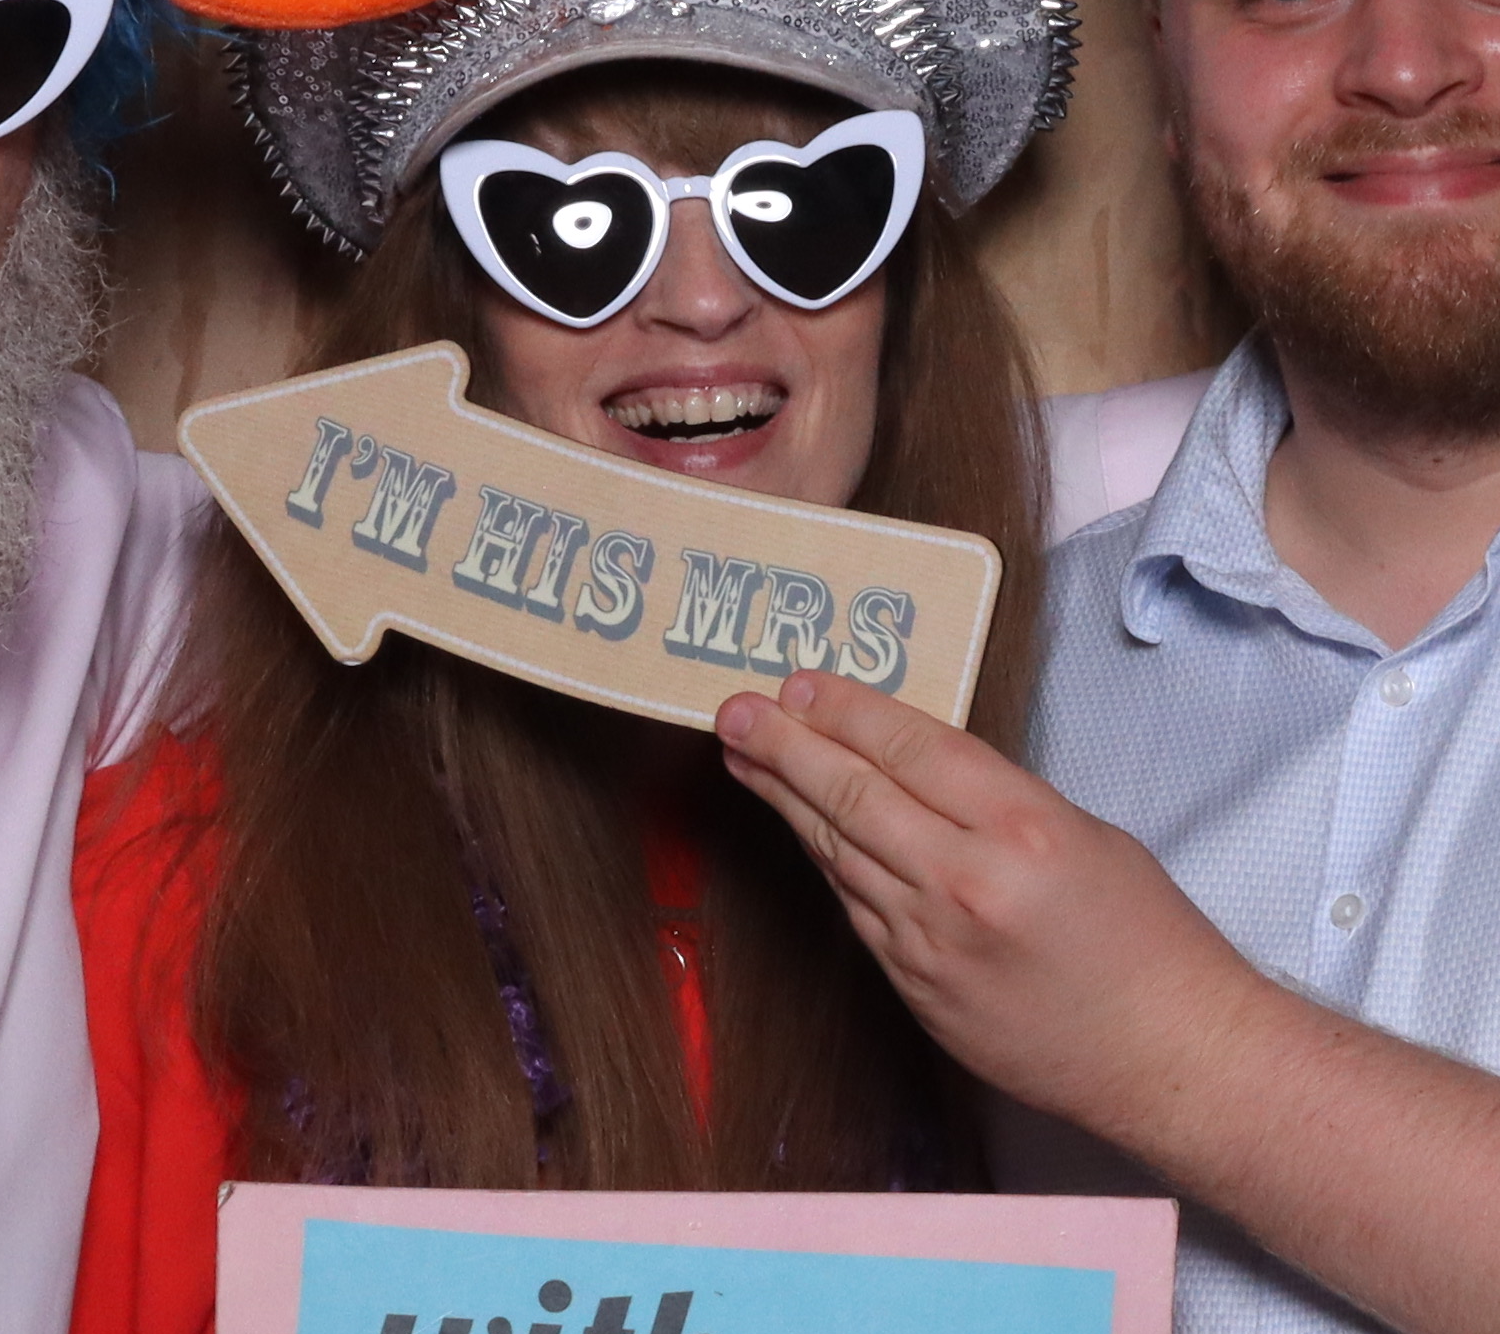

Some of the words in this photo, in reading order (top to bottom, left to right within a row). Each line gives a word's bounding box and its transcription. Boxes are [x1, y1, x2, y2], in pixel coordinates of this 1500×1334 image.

[286, 417, 455, 572] I'M
[453, 485, 654, 641] HIS
[662, 549, 918, 694] MRS
